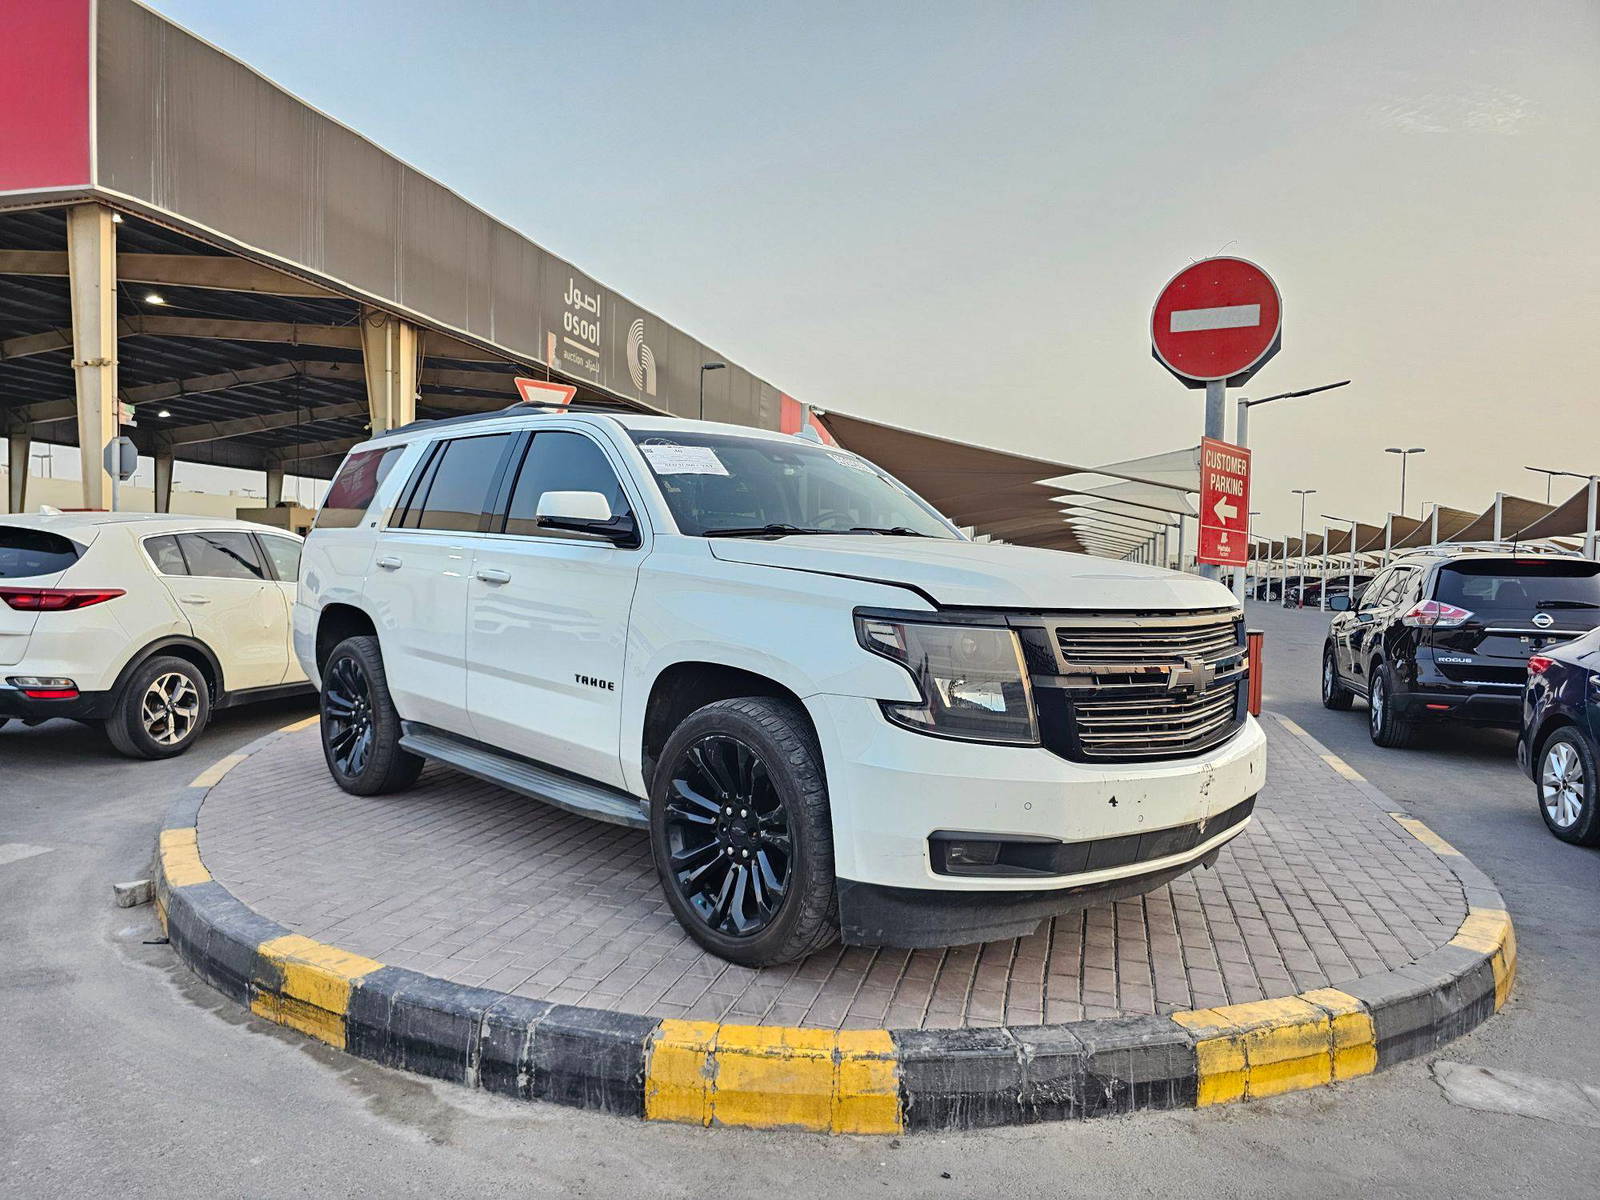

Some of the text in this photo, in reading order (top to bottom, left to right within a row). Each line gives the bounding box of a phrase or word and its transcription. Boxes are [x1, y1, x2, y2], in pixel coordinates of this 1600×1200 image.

[564, 277, 600, 317] اصول
[563, 350, 583, 366] auction
[1205, 450, 1247, 477] CUSTOMER
[1210, 473, 1243, 497] PARKING
[575, 673, 615, 692] TAHOE
